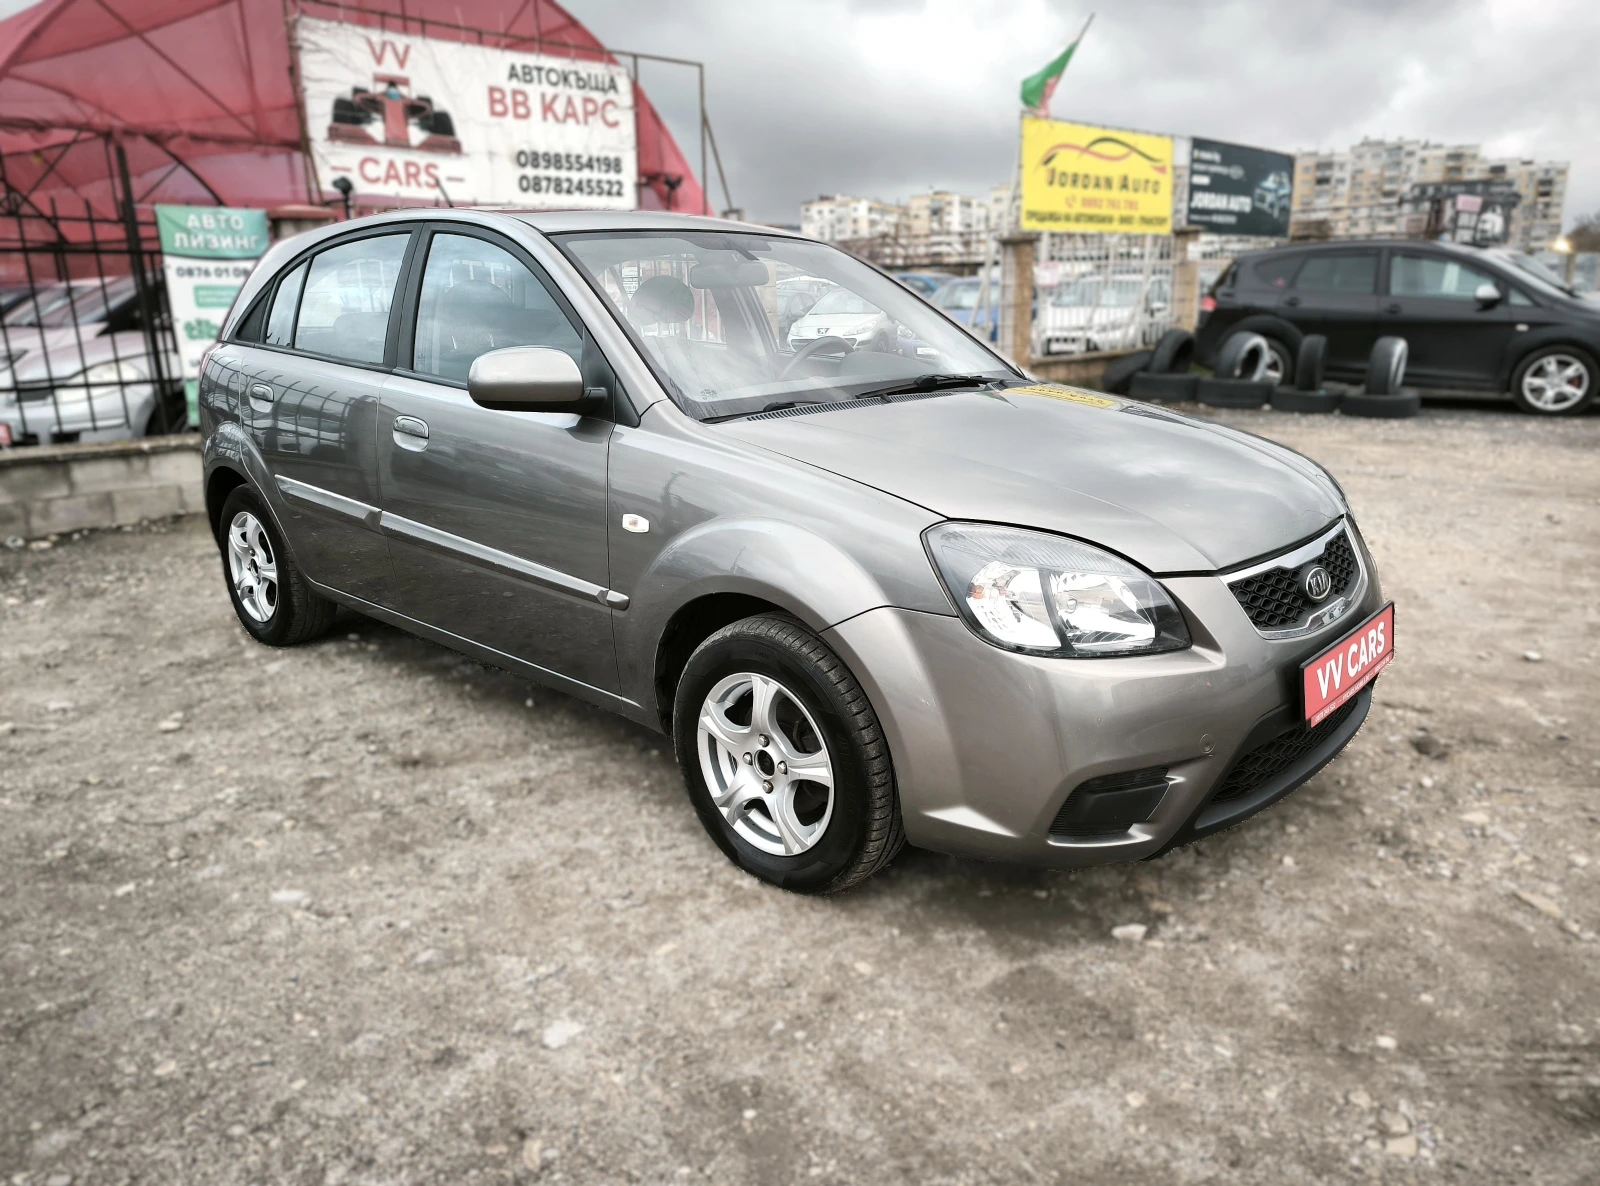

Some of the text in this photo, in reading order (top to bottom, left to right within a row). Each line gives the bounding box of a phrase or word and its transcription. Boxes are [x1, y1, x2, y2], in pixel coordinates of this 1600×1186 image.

[367, 36, 411, 70] VV
[507, 62, 619, 94] АВТОКЪЩА
[541, 93, 620, 129] КАРС
[358, 157, 440, 189] CARS
[516, 150, 622, 174] 0898554198
[518, 174, 624, 197] 0878245522
[187, 213, 244, 230] АВТО
[174, 233, 259, 250] ЛИЗИНГ
[1316, 621, 1385, 700] VV CARS
